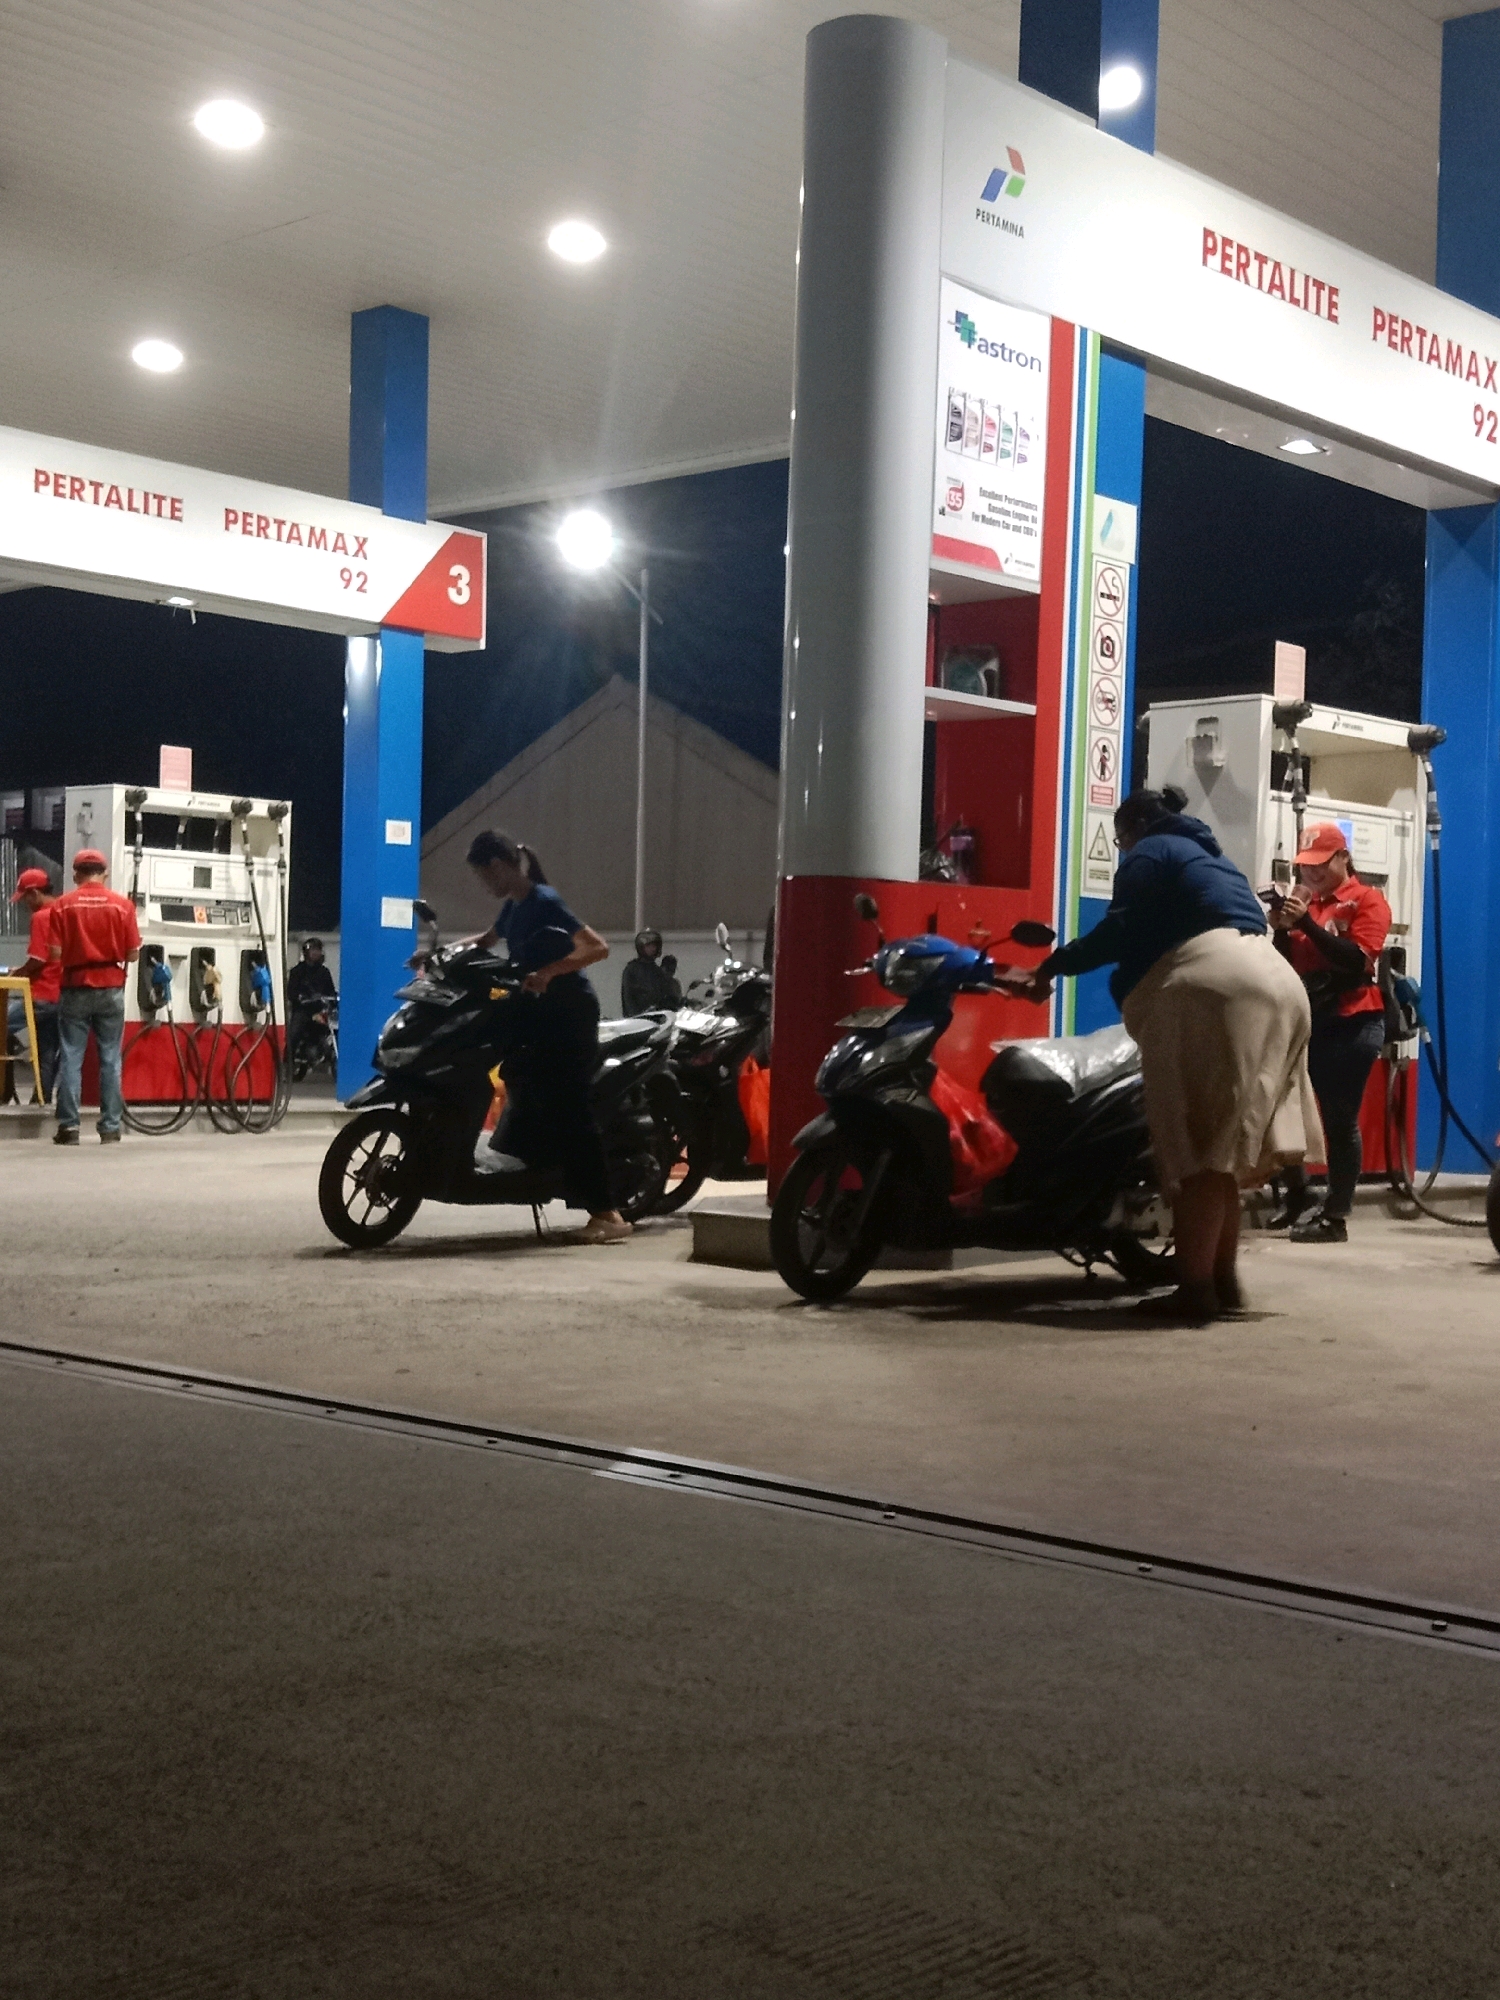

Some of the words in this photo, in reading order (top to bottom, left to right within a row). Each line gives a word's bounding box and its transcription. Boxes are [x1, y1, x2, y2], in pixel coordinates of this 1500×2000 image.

[975, 207, 1025, 239] PERTAMINA
[1202, 226, 1339, 325] PERTALITE
[964, 322, 1043, 373] Fastron
[1372, 305, 1498, 394] PERTAMAX
[1473, 402, 1498, 444] 92
[34, 468, 184, 522] PERTALITE
[224, 507, 369, 561] PERTAMAX
[339, 567, 369, 594] 92
[447, 563, 471, 606] 3
